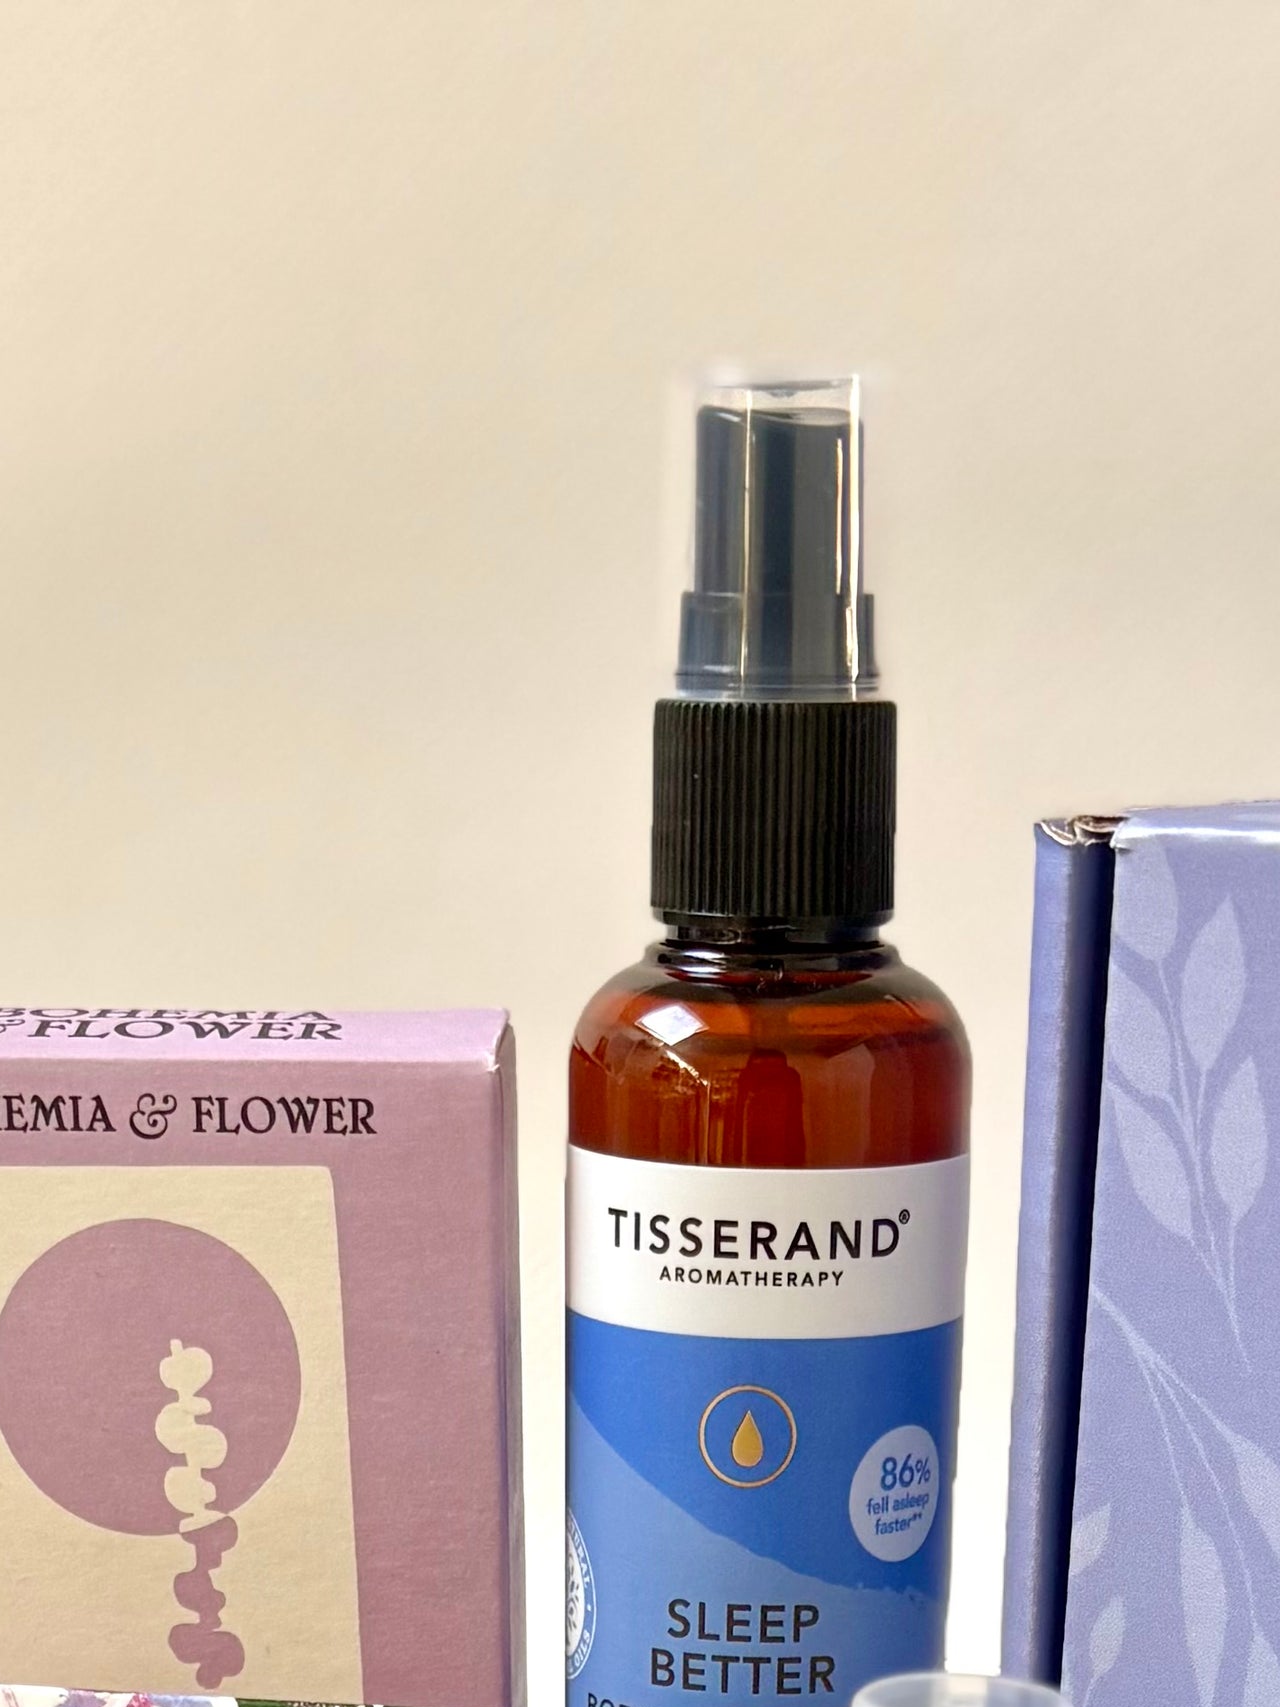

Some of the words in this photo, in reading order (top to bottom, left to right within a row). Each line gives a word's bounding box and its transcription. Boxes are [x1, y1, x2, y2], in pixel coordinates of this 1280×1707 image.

[27, 1019, 343, 1041] FLOWER
[128, 1092, 179, 1140] &
[191, 1096, 378, 1136] FLOWER
[658, 1265, 845, 1287] AROMATHERAPY
[880, 1452, 932, 1492] 86%
[865, 1495, 890, 1515] fell
[892, 1493, 930, 1512] asleep
[666, 1598, 821, 1645] SLEEP
[650, 1647, 837, 1696] BETTER
